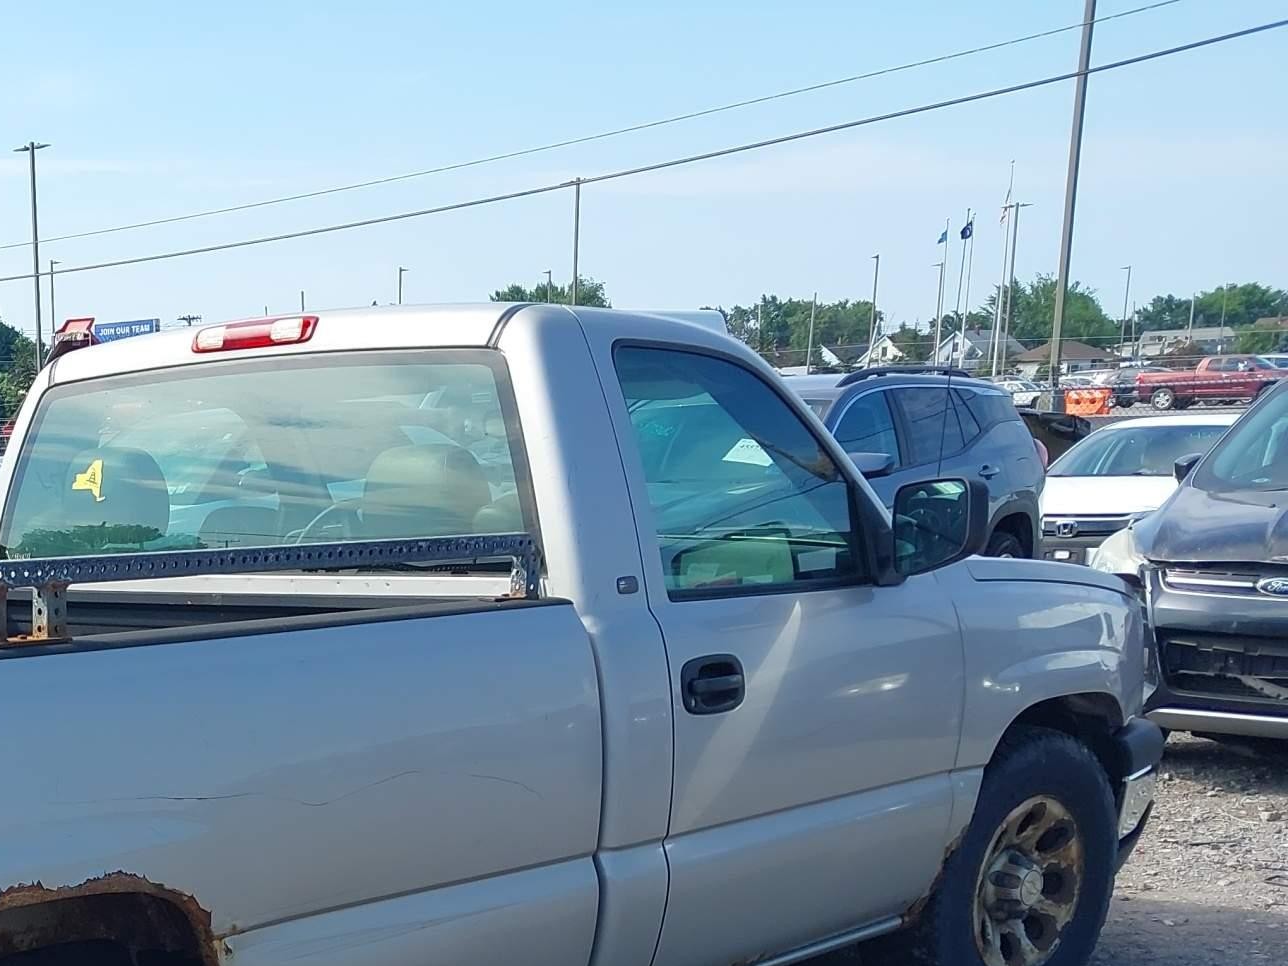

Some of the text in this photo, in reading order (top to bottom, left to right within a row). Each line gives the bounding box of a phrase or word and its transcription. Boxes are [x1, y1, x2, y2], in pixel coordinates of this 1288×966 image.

[99, 323, 150, 336] JOIN OUR TEAM
